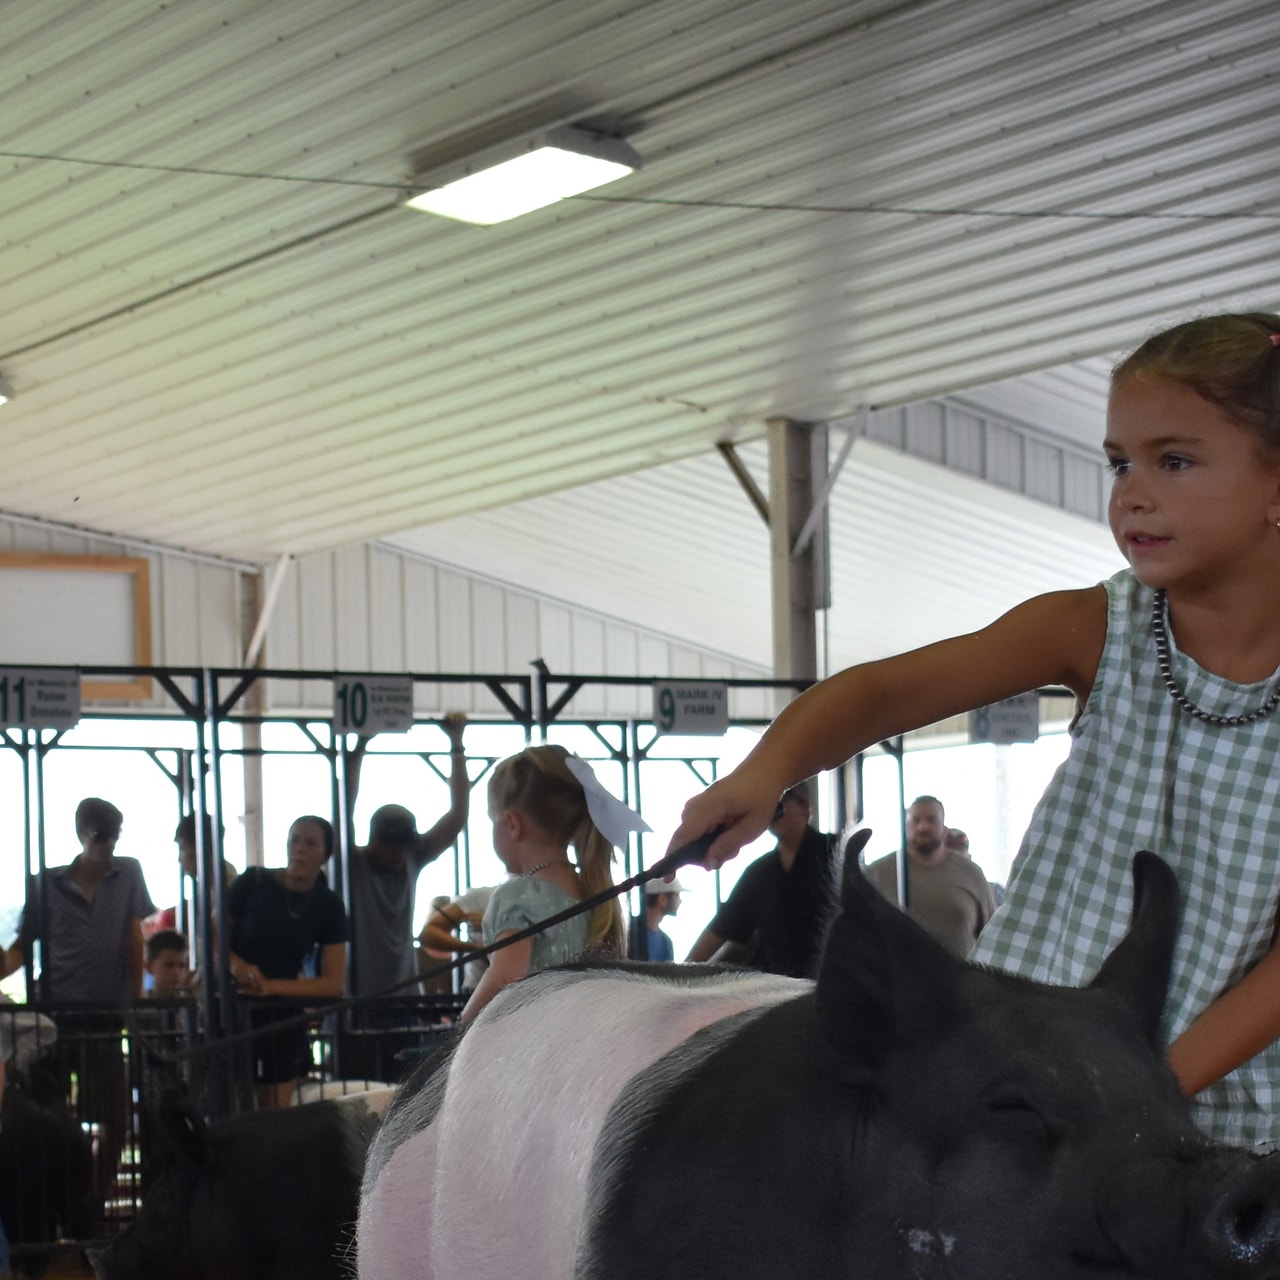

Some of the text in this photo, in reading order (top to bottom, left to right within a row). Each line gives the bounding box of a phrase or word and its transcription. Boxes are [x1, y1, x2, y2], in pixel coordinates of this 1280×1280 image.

[337, 682, 367, 728] 10
[676, 689, 723, 700] MARK IV
[659, 688, 675, 732] 9
[684, 704, 715, 715] FARM
